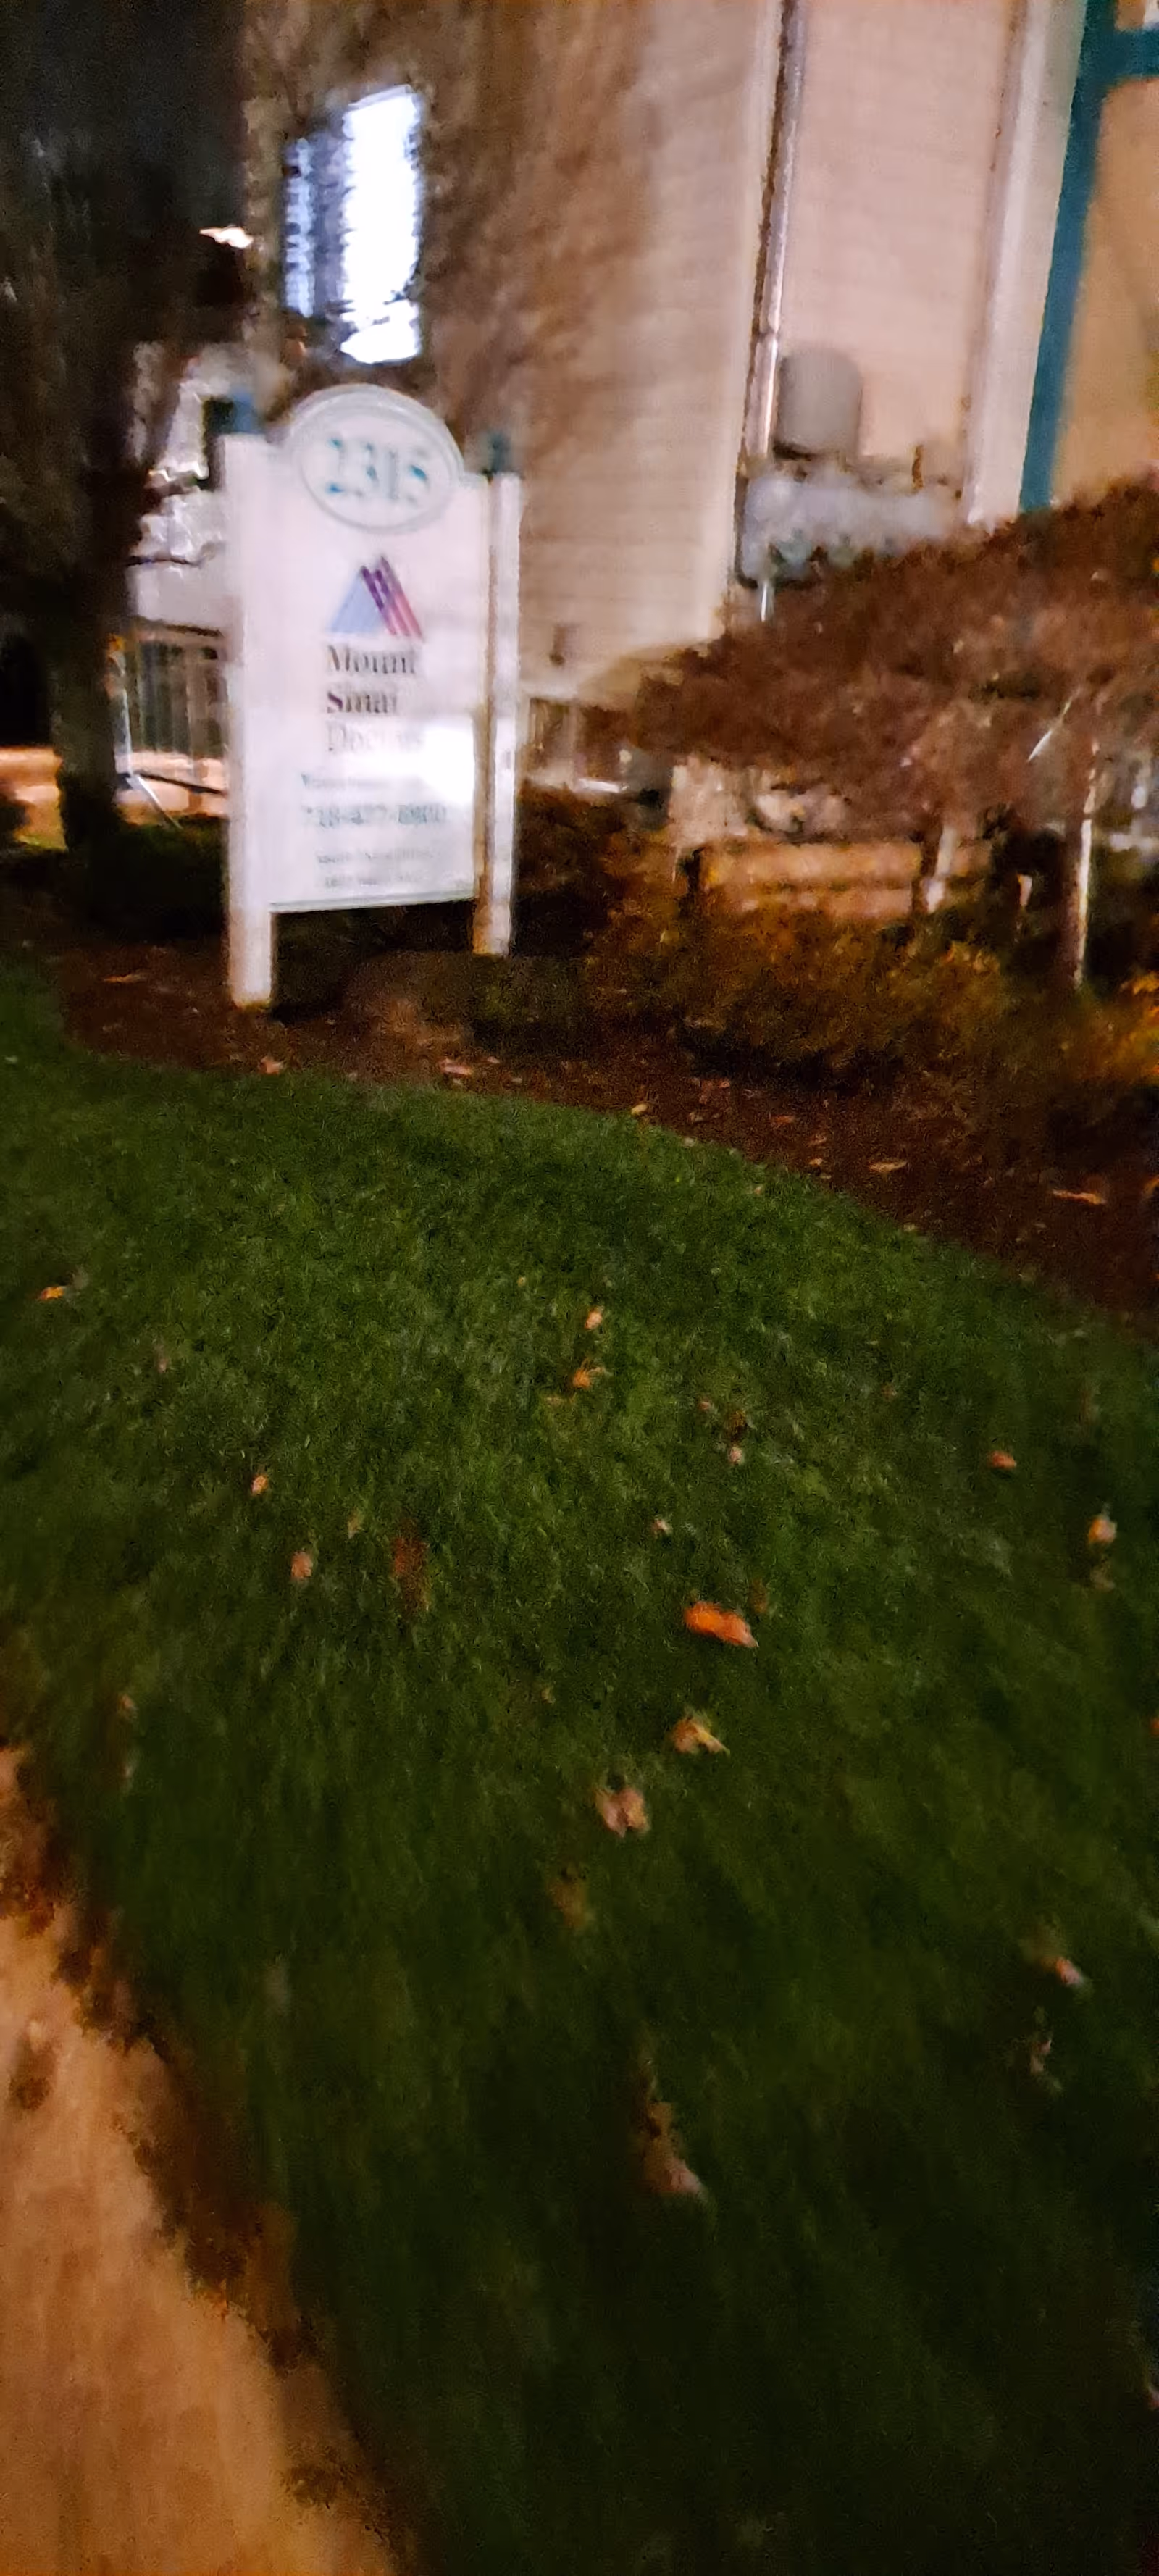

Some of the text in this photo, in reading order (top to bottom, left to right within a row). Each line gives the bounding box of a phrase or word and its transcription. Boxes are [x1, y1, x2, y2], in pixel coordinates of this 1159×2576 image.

[324, 436, 432, 507] 2315
[326, 643, 418, 675] Mount
[326, 688, 398, 714] Sinai
